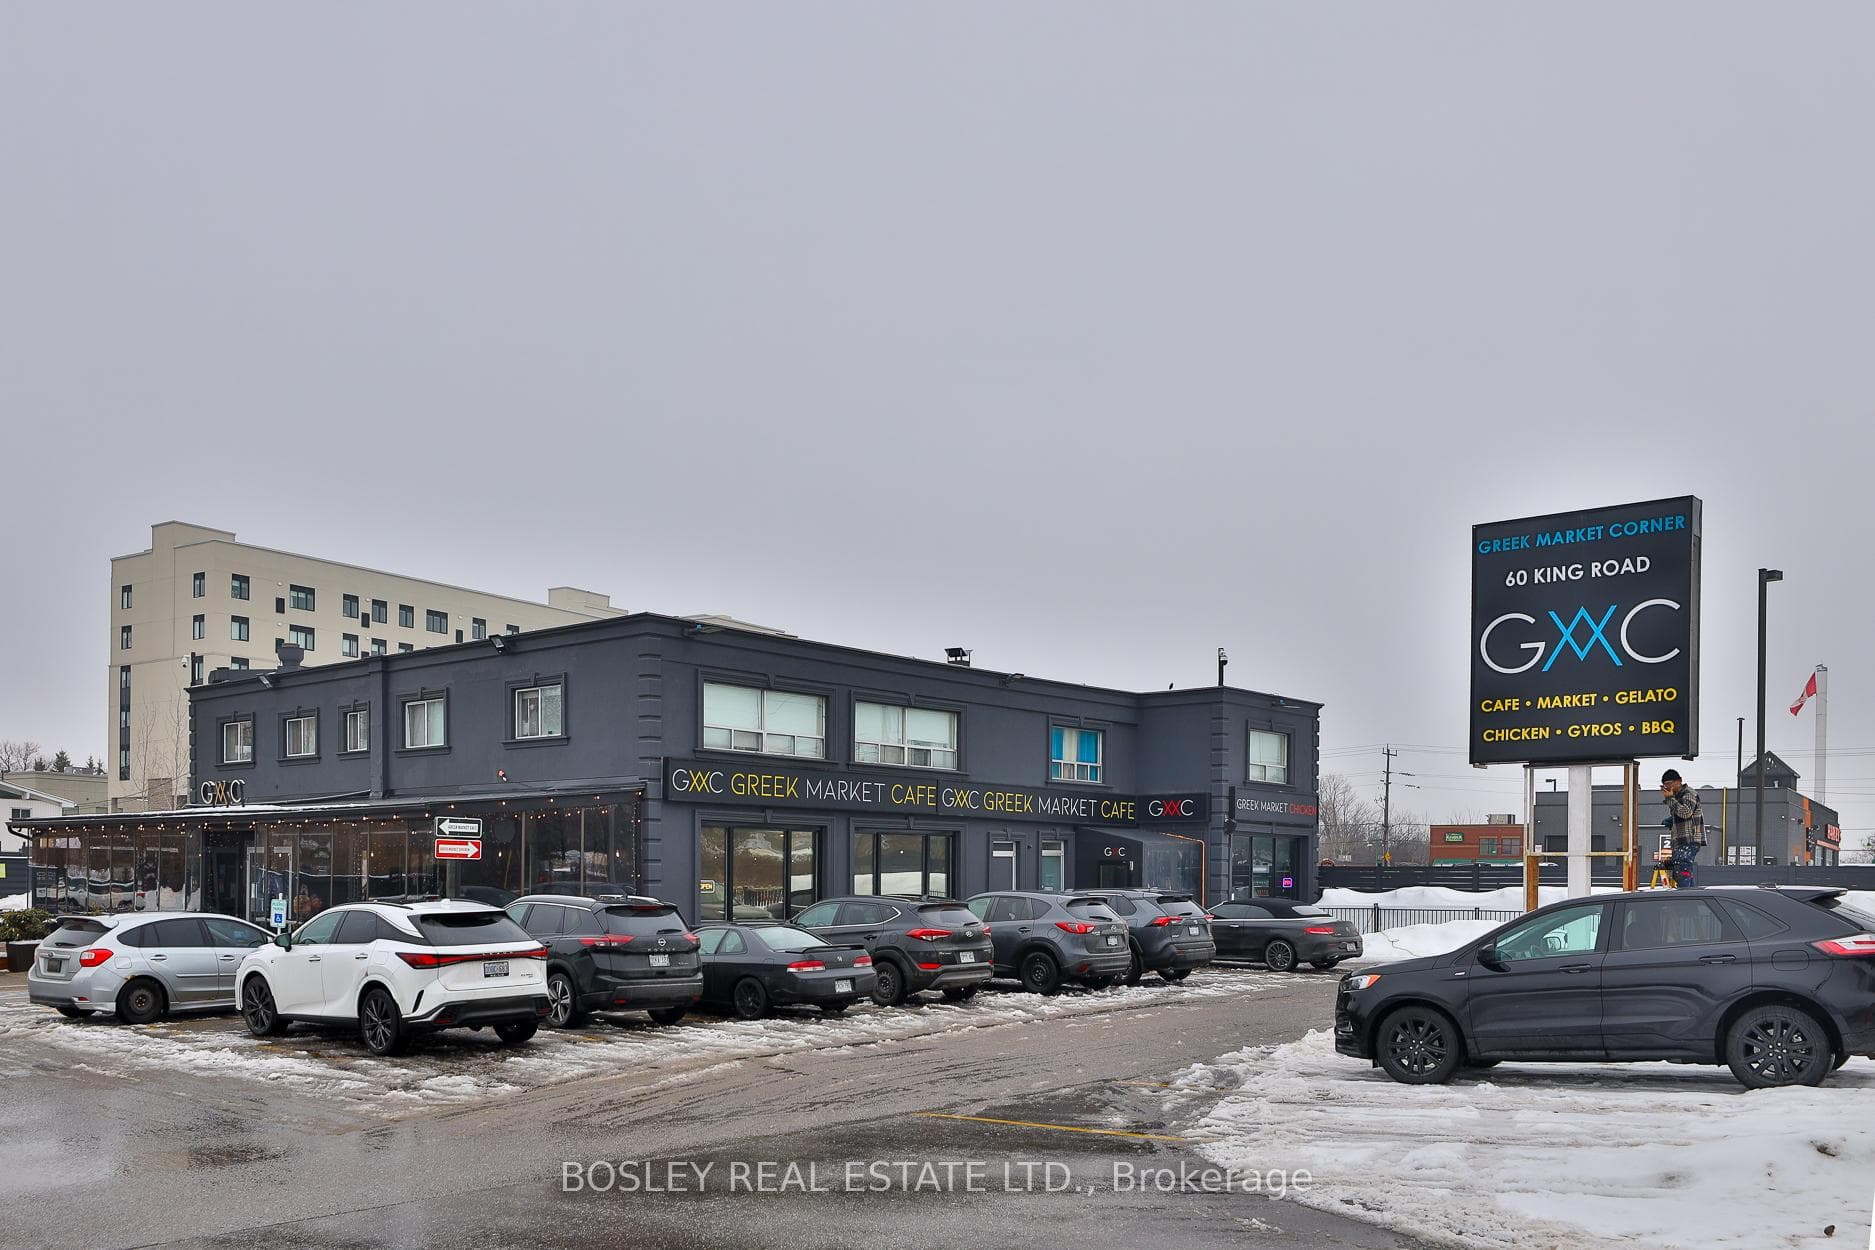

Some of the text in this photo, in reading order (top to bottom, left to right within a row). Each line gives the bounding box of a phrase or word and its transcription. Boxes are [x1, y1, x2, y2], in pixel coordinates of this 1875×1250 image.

[1478, 515, 1686, 554] GREEK MARKET CORNER
[1505, 556, 1651, 587] 60 KING ROAD
[1481, 687, 1677, 712] CAFE MARKET GELATO
[1482, 720, 1675, 742] CHICKEN GYROS BBQ
[730, 773, 799, 798] GREEK
[806, 779, 885, 803] MARKET
[891, 784, 937, 806] CAFE
[983, 791, 1033, 813] GREEK
[1038, 796, 1097, 817] MARKET
[1101, 800, 1135, 820] CAFE
[1237, 799, 1259, 811] GREEK
[1260, 801, 1288, 813] MARKET
